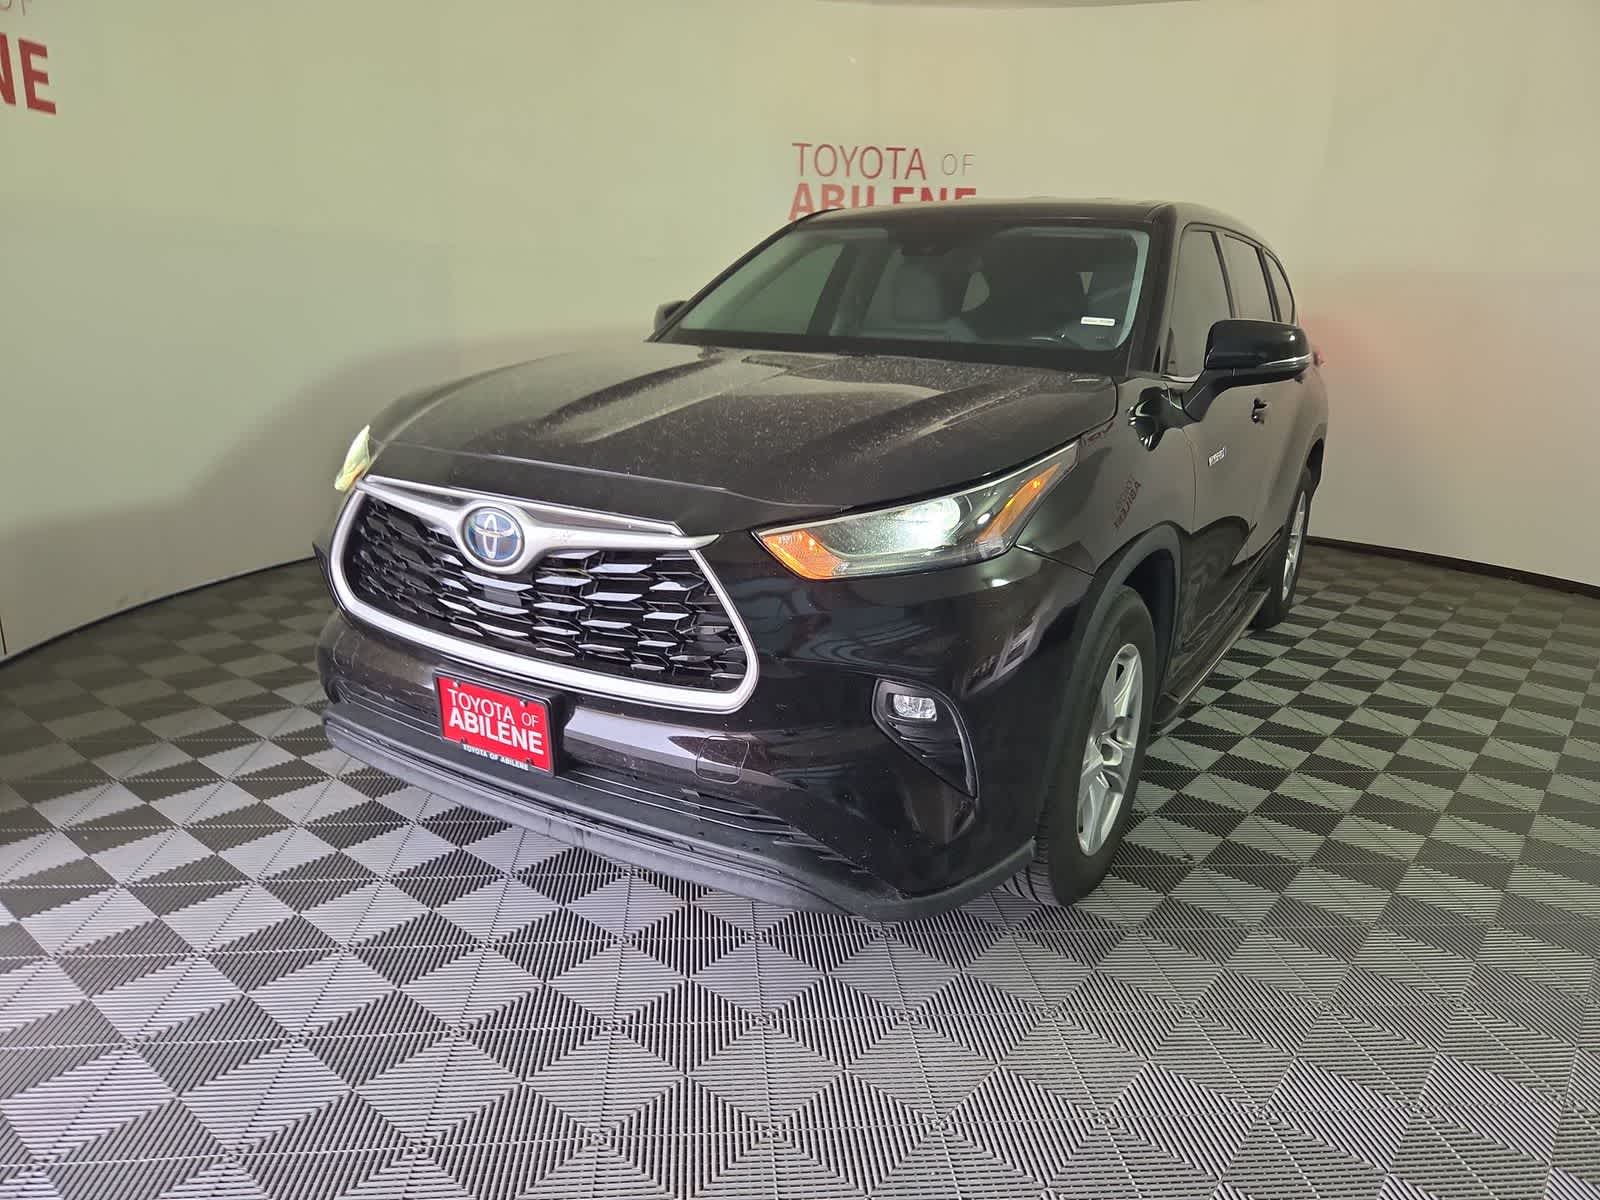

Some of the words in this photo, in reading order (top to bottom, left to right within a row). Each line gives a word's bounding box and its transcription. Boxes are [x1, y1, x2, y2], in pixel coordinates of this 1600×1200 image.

[791, 142, 926, 180] TOYOTA
[941, 153, 976, 177] OF
[447, 688, 516, 724] TOYOTA
[521, 712, 539, 727] OF
[449, 707, 545, 755] ABILENE
[462, 743, 488, 758] TOYOTA
